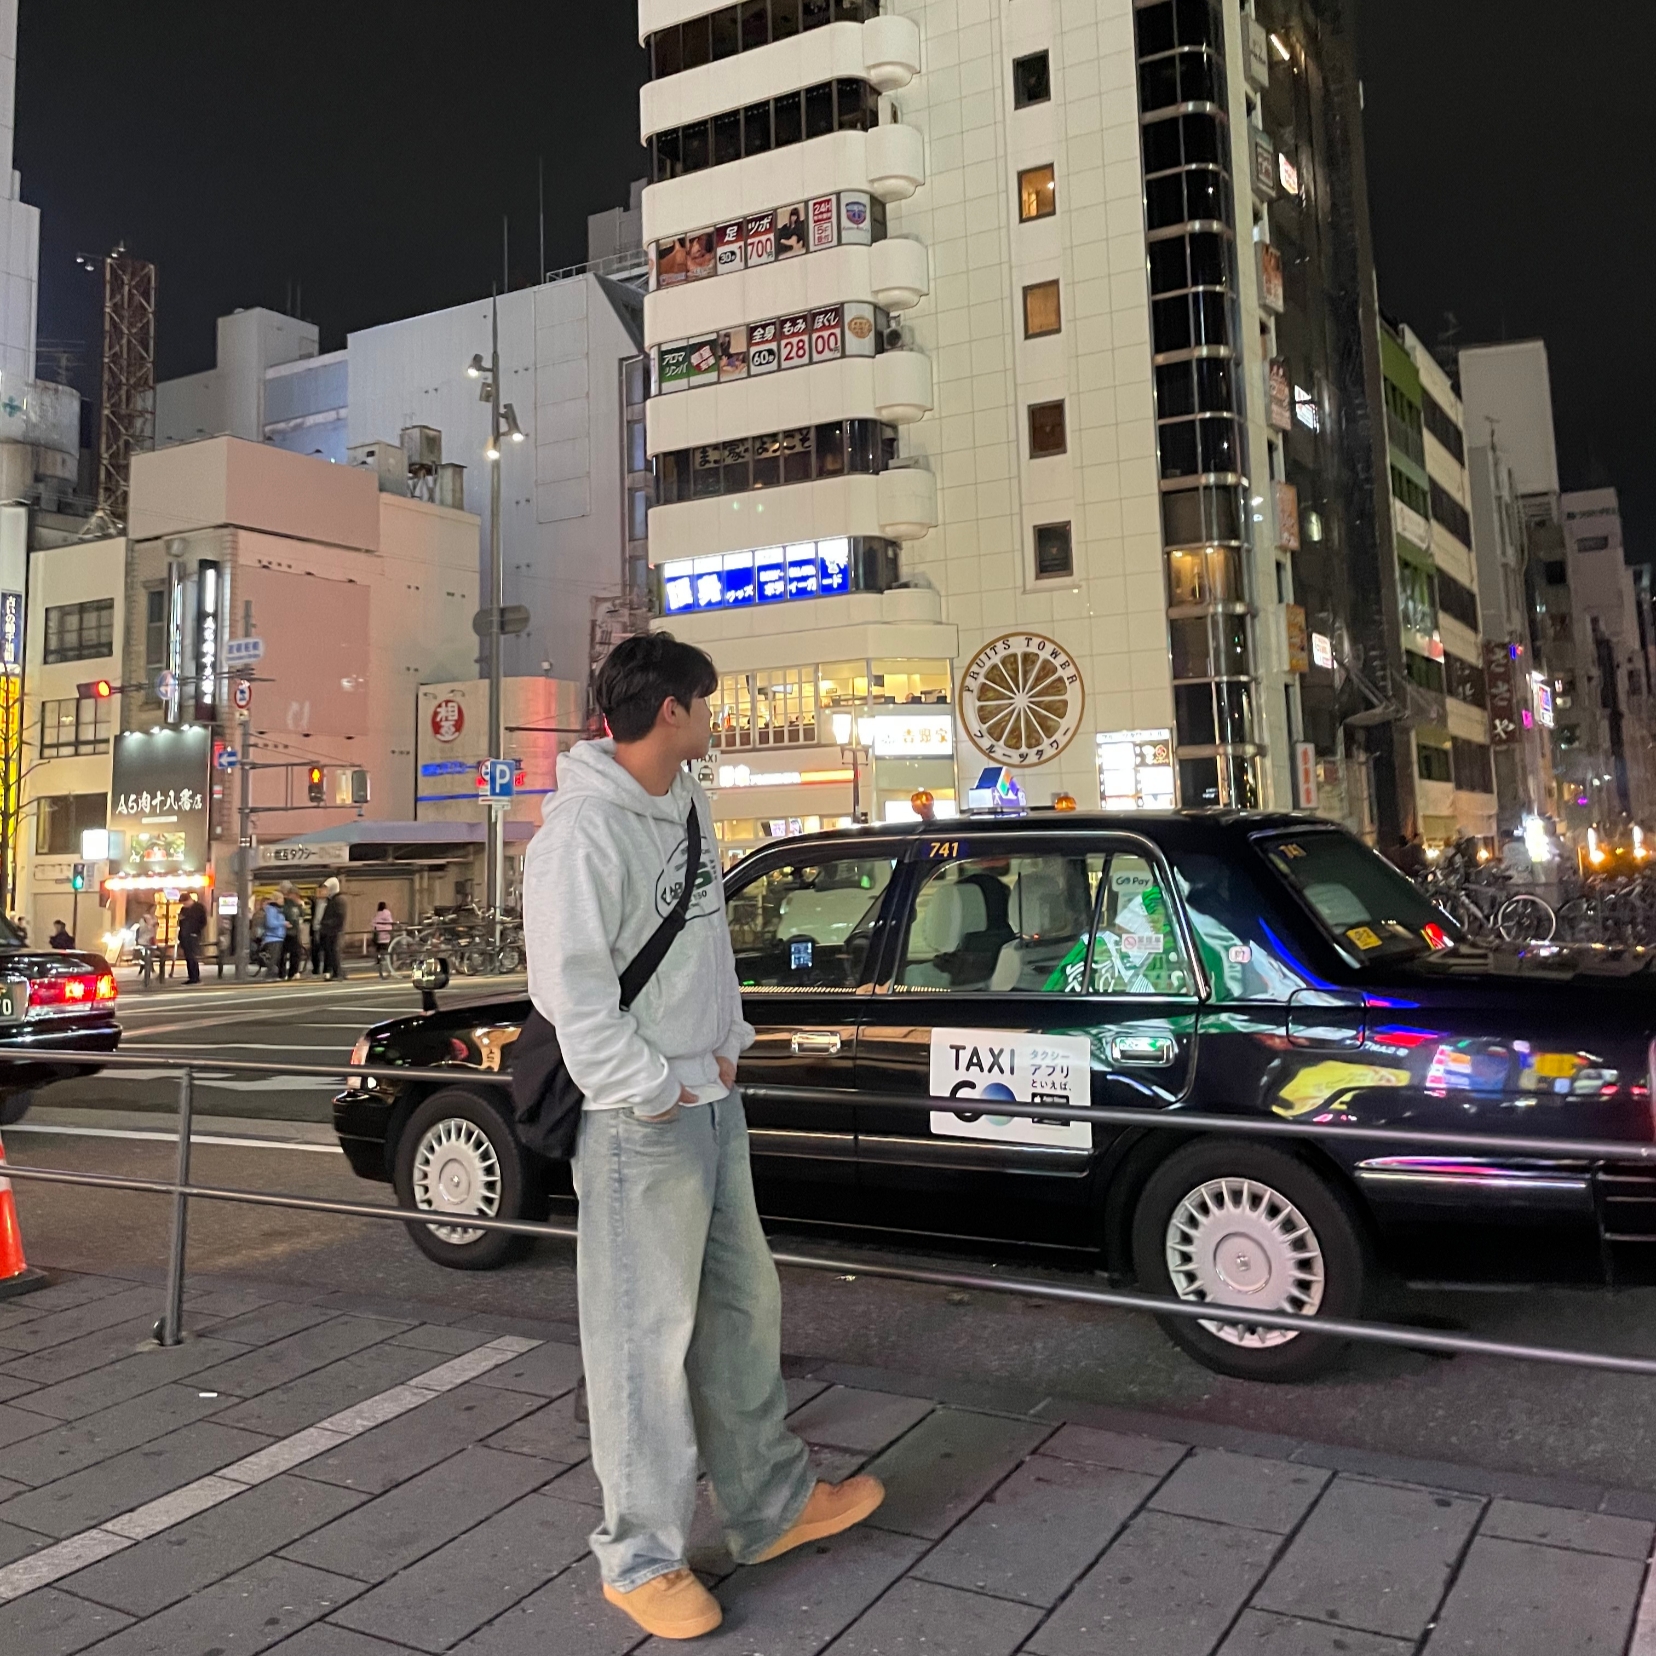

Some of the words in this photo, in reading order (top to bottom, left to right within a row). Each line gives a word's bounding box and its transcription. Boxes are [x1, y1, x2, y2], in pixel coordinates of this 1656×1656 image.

[814, 202, 832, 214] 24H
[662, 352, 686, 366] アロマ
[665, 361, 688, 377] リンパ
[1024, 636, 1078, 685] TOWER
[973, 727, 1072, 763] フルーツタワー
[495, 763, 511, 794] P
[929, 841, 959, 858] 741
[1132, 876, 1150, 887] Pay
[949, 1044, 1016, 1076] TAXI
[1029, 1049, 1071, 1062] タクシー
[1030, 1063, 1070, 1079] アプリ
